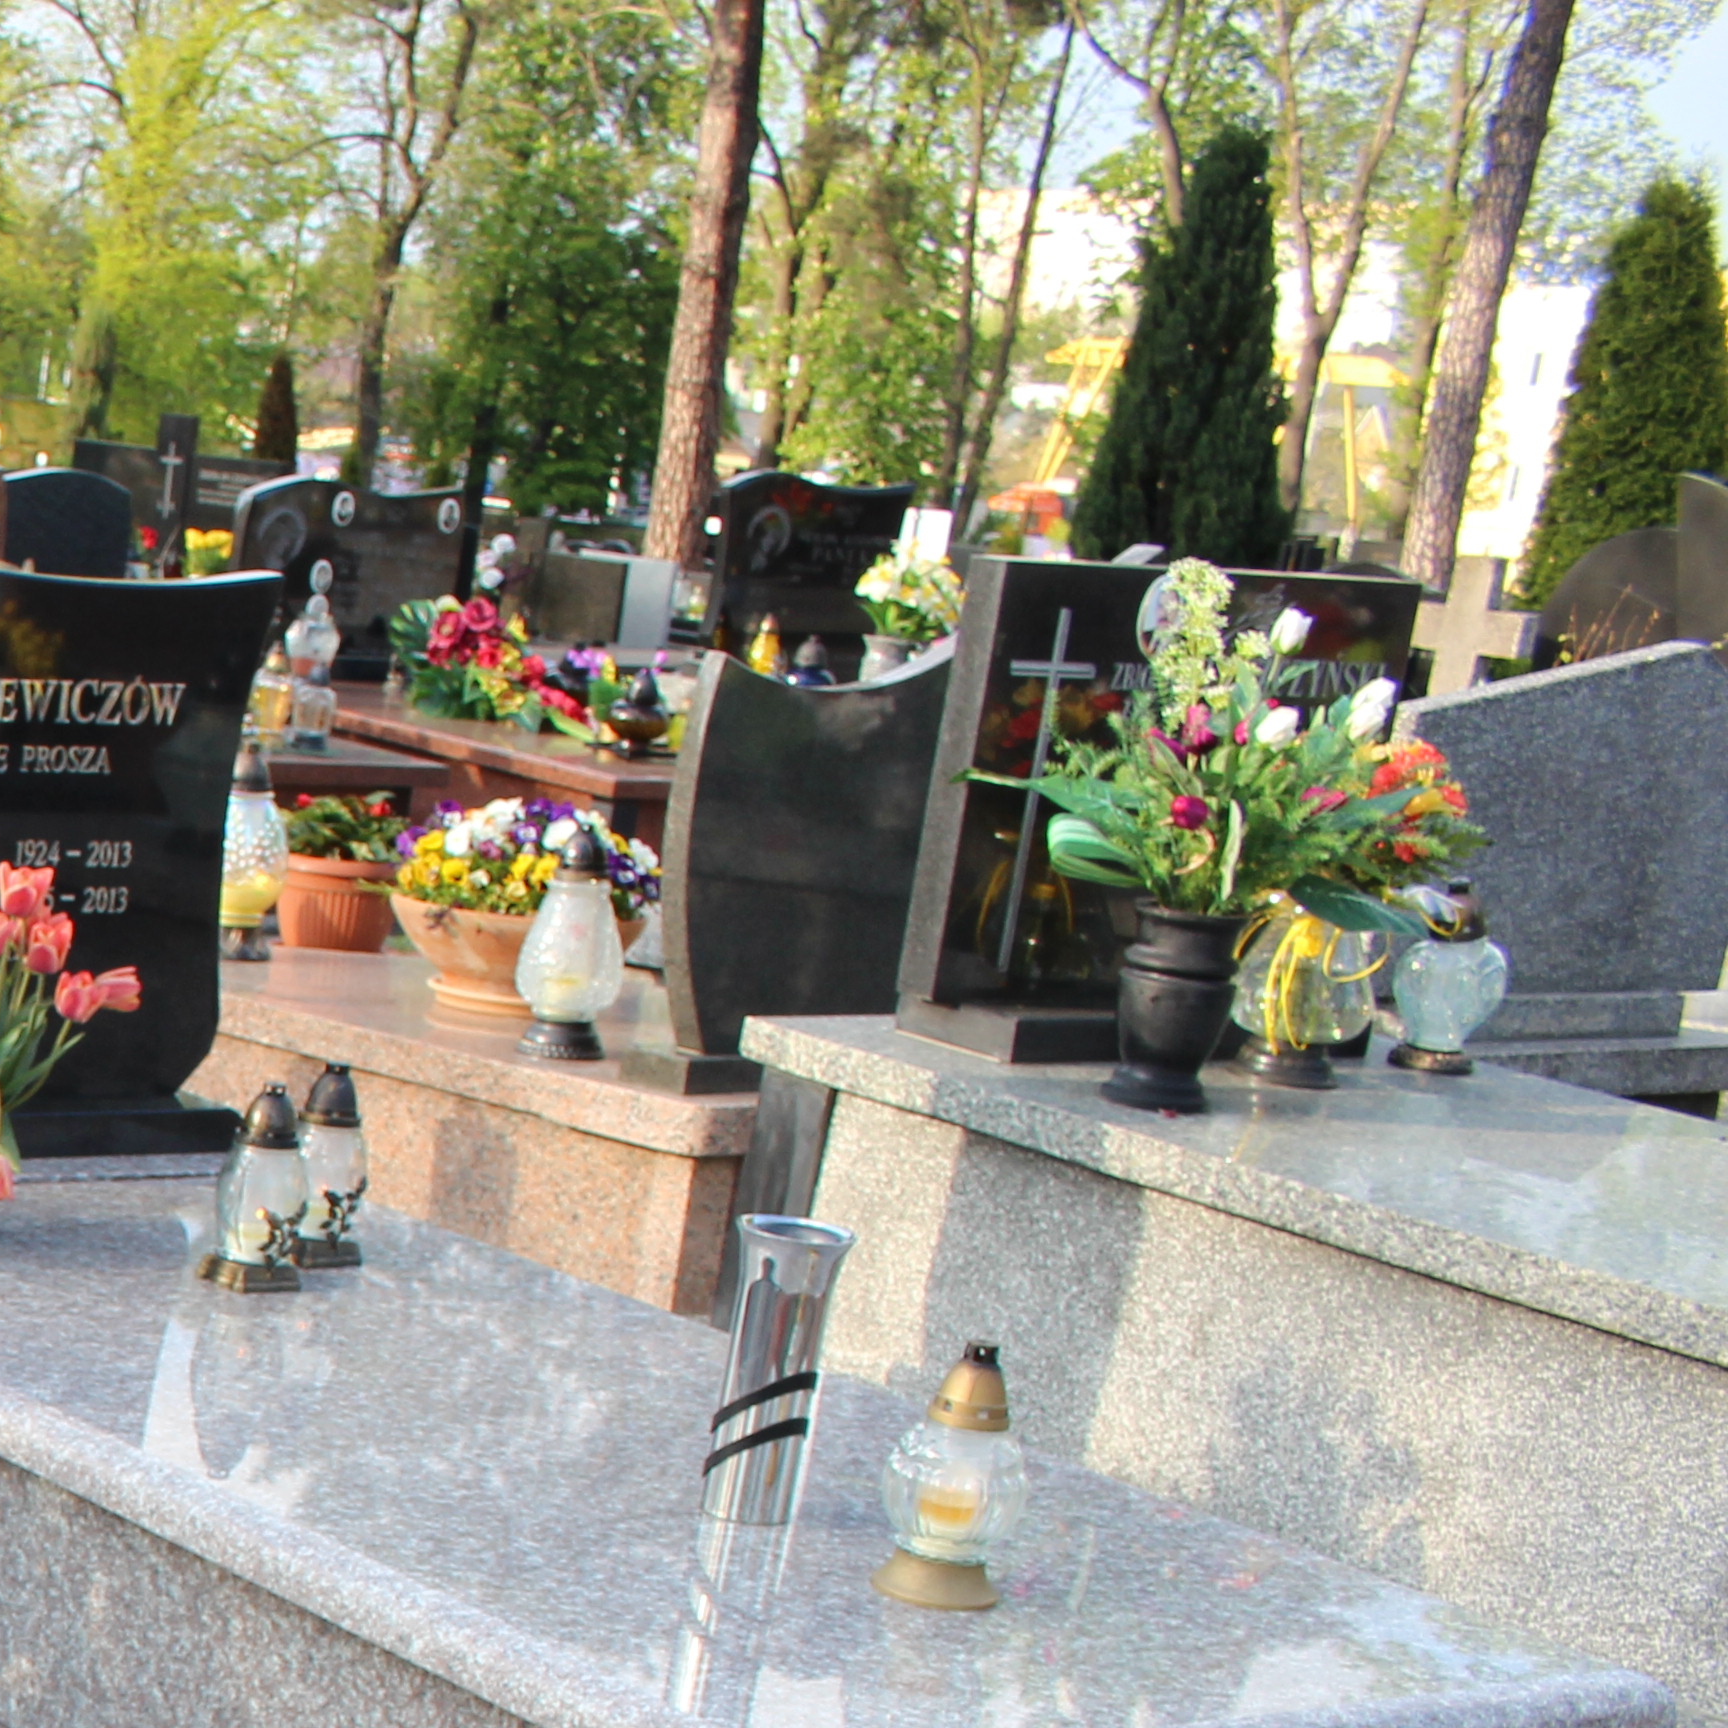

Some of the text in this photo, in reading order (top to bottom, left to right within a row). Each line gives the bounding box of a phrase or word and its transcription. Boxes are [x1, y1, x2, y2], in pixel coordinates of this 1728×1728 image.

[14, 839, 61, 867] 1924
[84, 840, 133, 868] 2013
[81, 886, 129, 914] 2013
